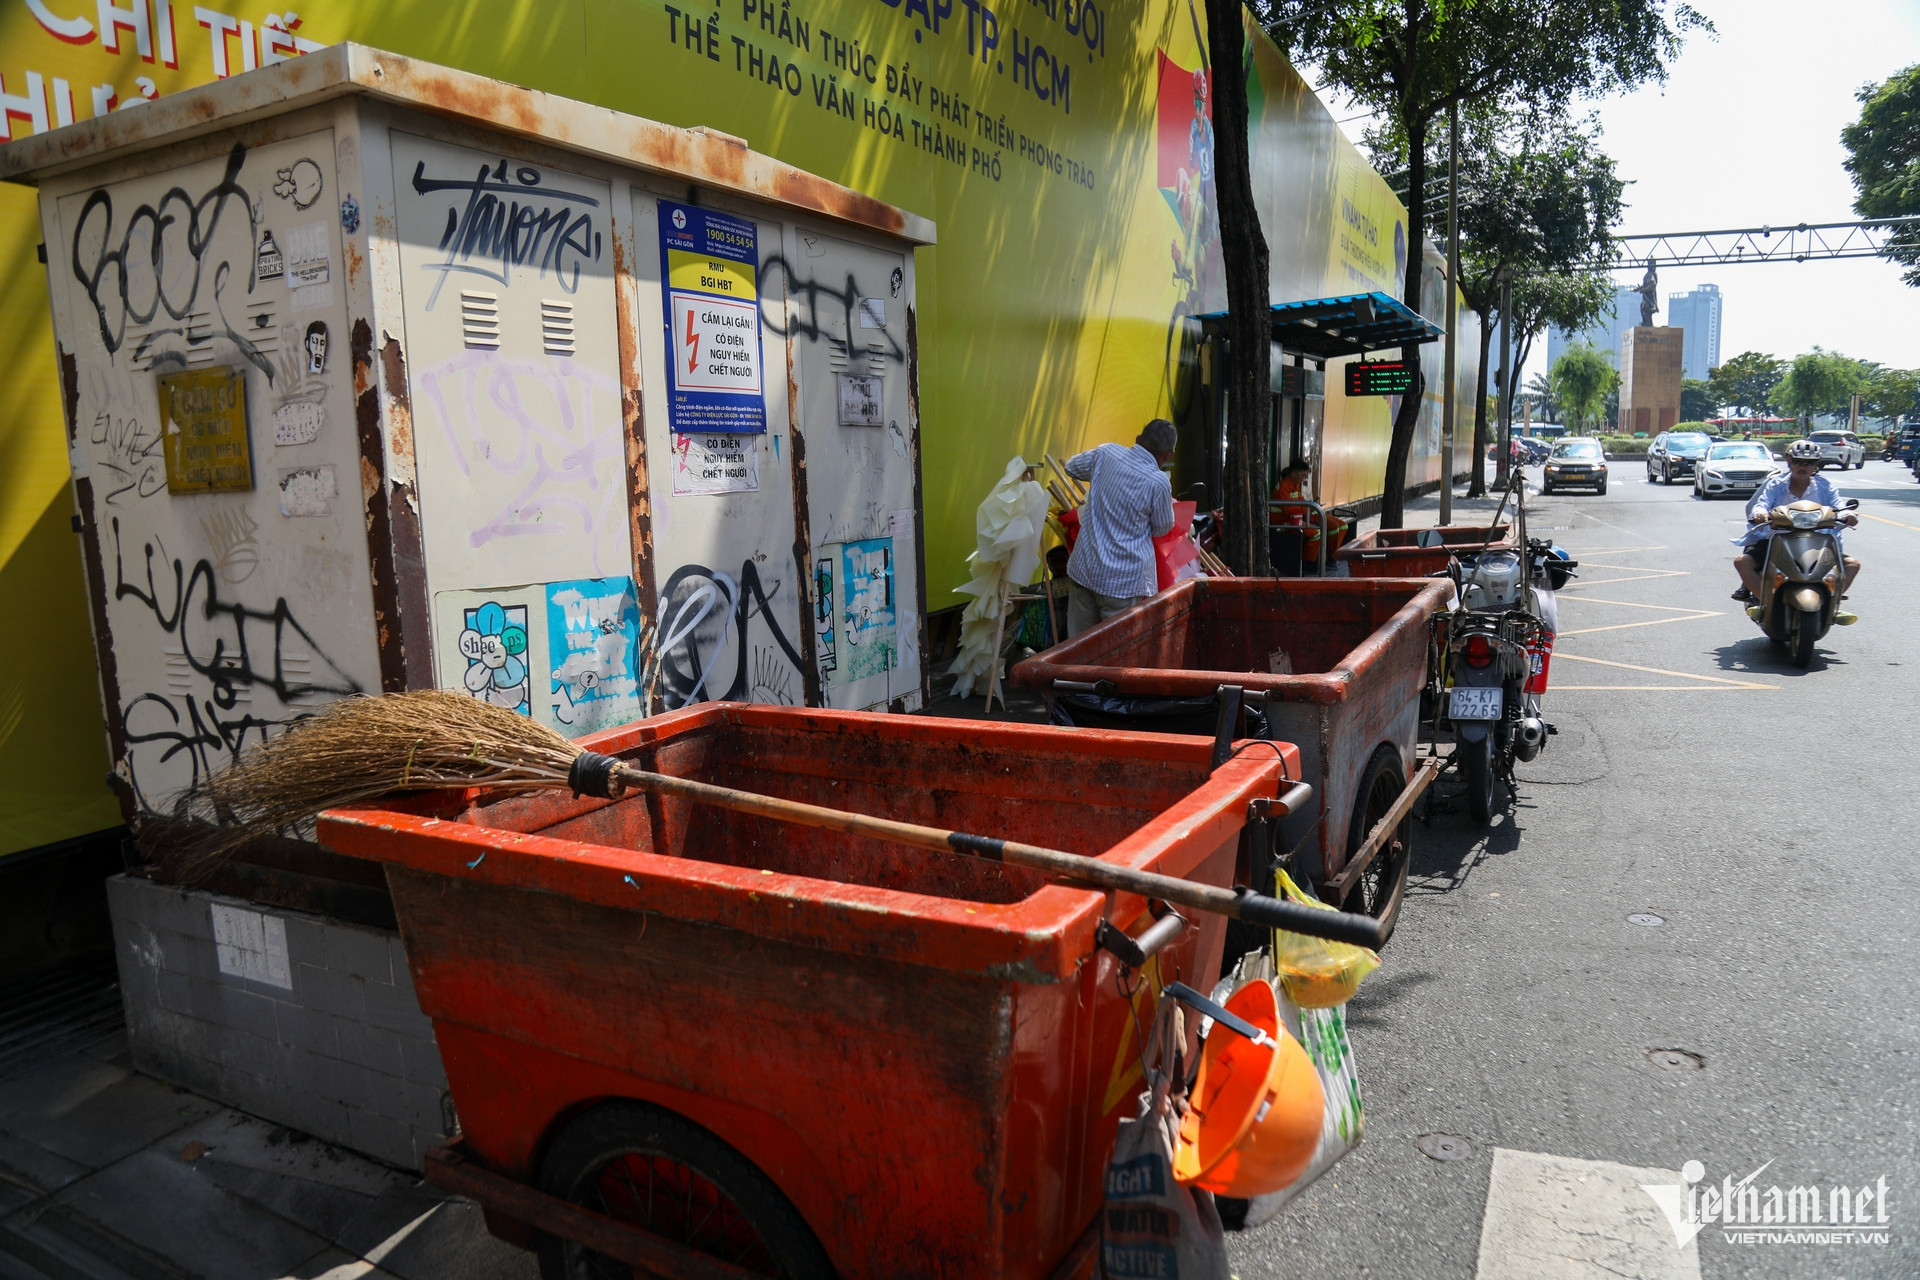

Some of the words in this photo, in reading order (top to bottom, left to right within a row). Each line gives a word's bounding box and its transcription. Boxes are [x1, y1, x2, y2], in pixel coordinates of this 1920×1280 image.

[1012, 28, 1070, 115] HCM
[665, 4, 720, 62] THỂ
[731, 35, 802, 96] THAO
[811, 74, 855, 121] VĂN
[864, 97, 904, 141] HÓA
[911, 119, 967, 168] THÀNH
[972, 146, 1002, 182] PHỐ
[743, 0, 810, 53] PHẦN
[820, 29, 877, 84] THÚC
[886, 62, 922, 106] ĐẨY
[931, 87, 970, 129] PHÁT
[975, 110, 1015, 153] TRIỂN
[1020, 134, 1063, 176] PHONG
[1067, 158, 1095, 190] TRÀO
[706, 228, 725, 242] 1900
[725, 233, 735, 245] 54
[736, 235, 745, 247] 54
[745, 238, 754, 249] 54
[258, 263, 283, 275] BRICKS
[708, 262, 724, 272] RMU
[717, 279, 732, 291] HBT
[701, 311, 720, 325] CẤM
[721, 316, 734, 329] LẠI
[715, 333, 726, 344] CÓ
[727, 334, 744, 348] ĐIỆN
[710, 349, 731, 360] NGUY
[709, 362, 728, 375] CHẾT
[730, 366, 752, 378] NGƯỜI
[707, 437, 718, 448] CÓ
[704, 454, 724, 464] NGUY
[702, 466, 722, 479] CHẾT
[725, 467, 747, 478] NGƯỜI
[1458, 690, 1493, 703] 64-K1
[1453, 704, 1498, 717] 022.65
